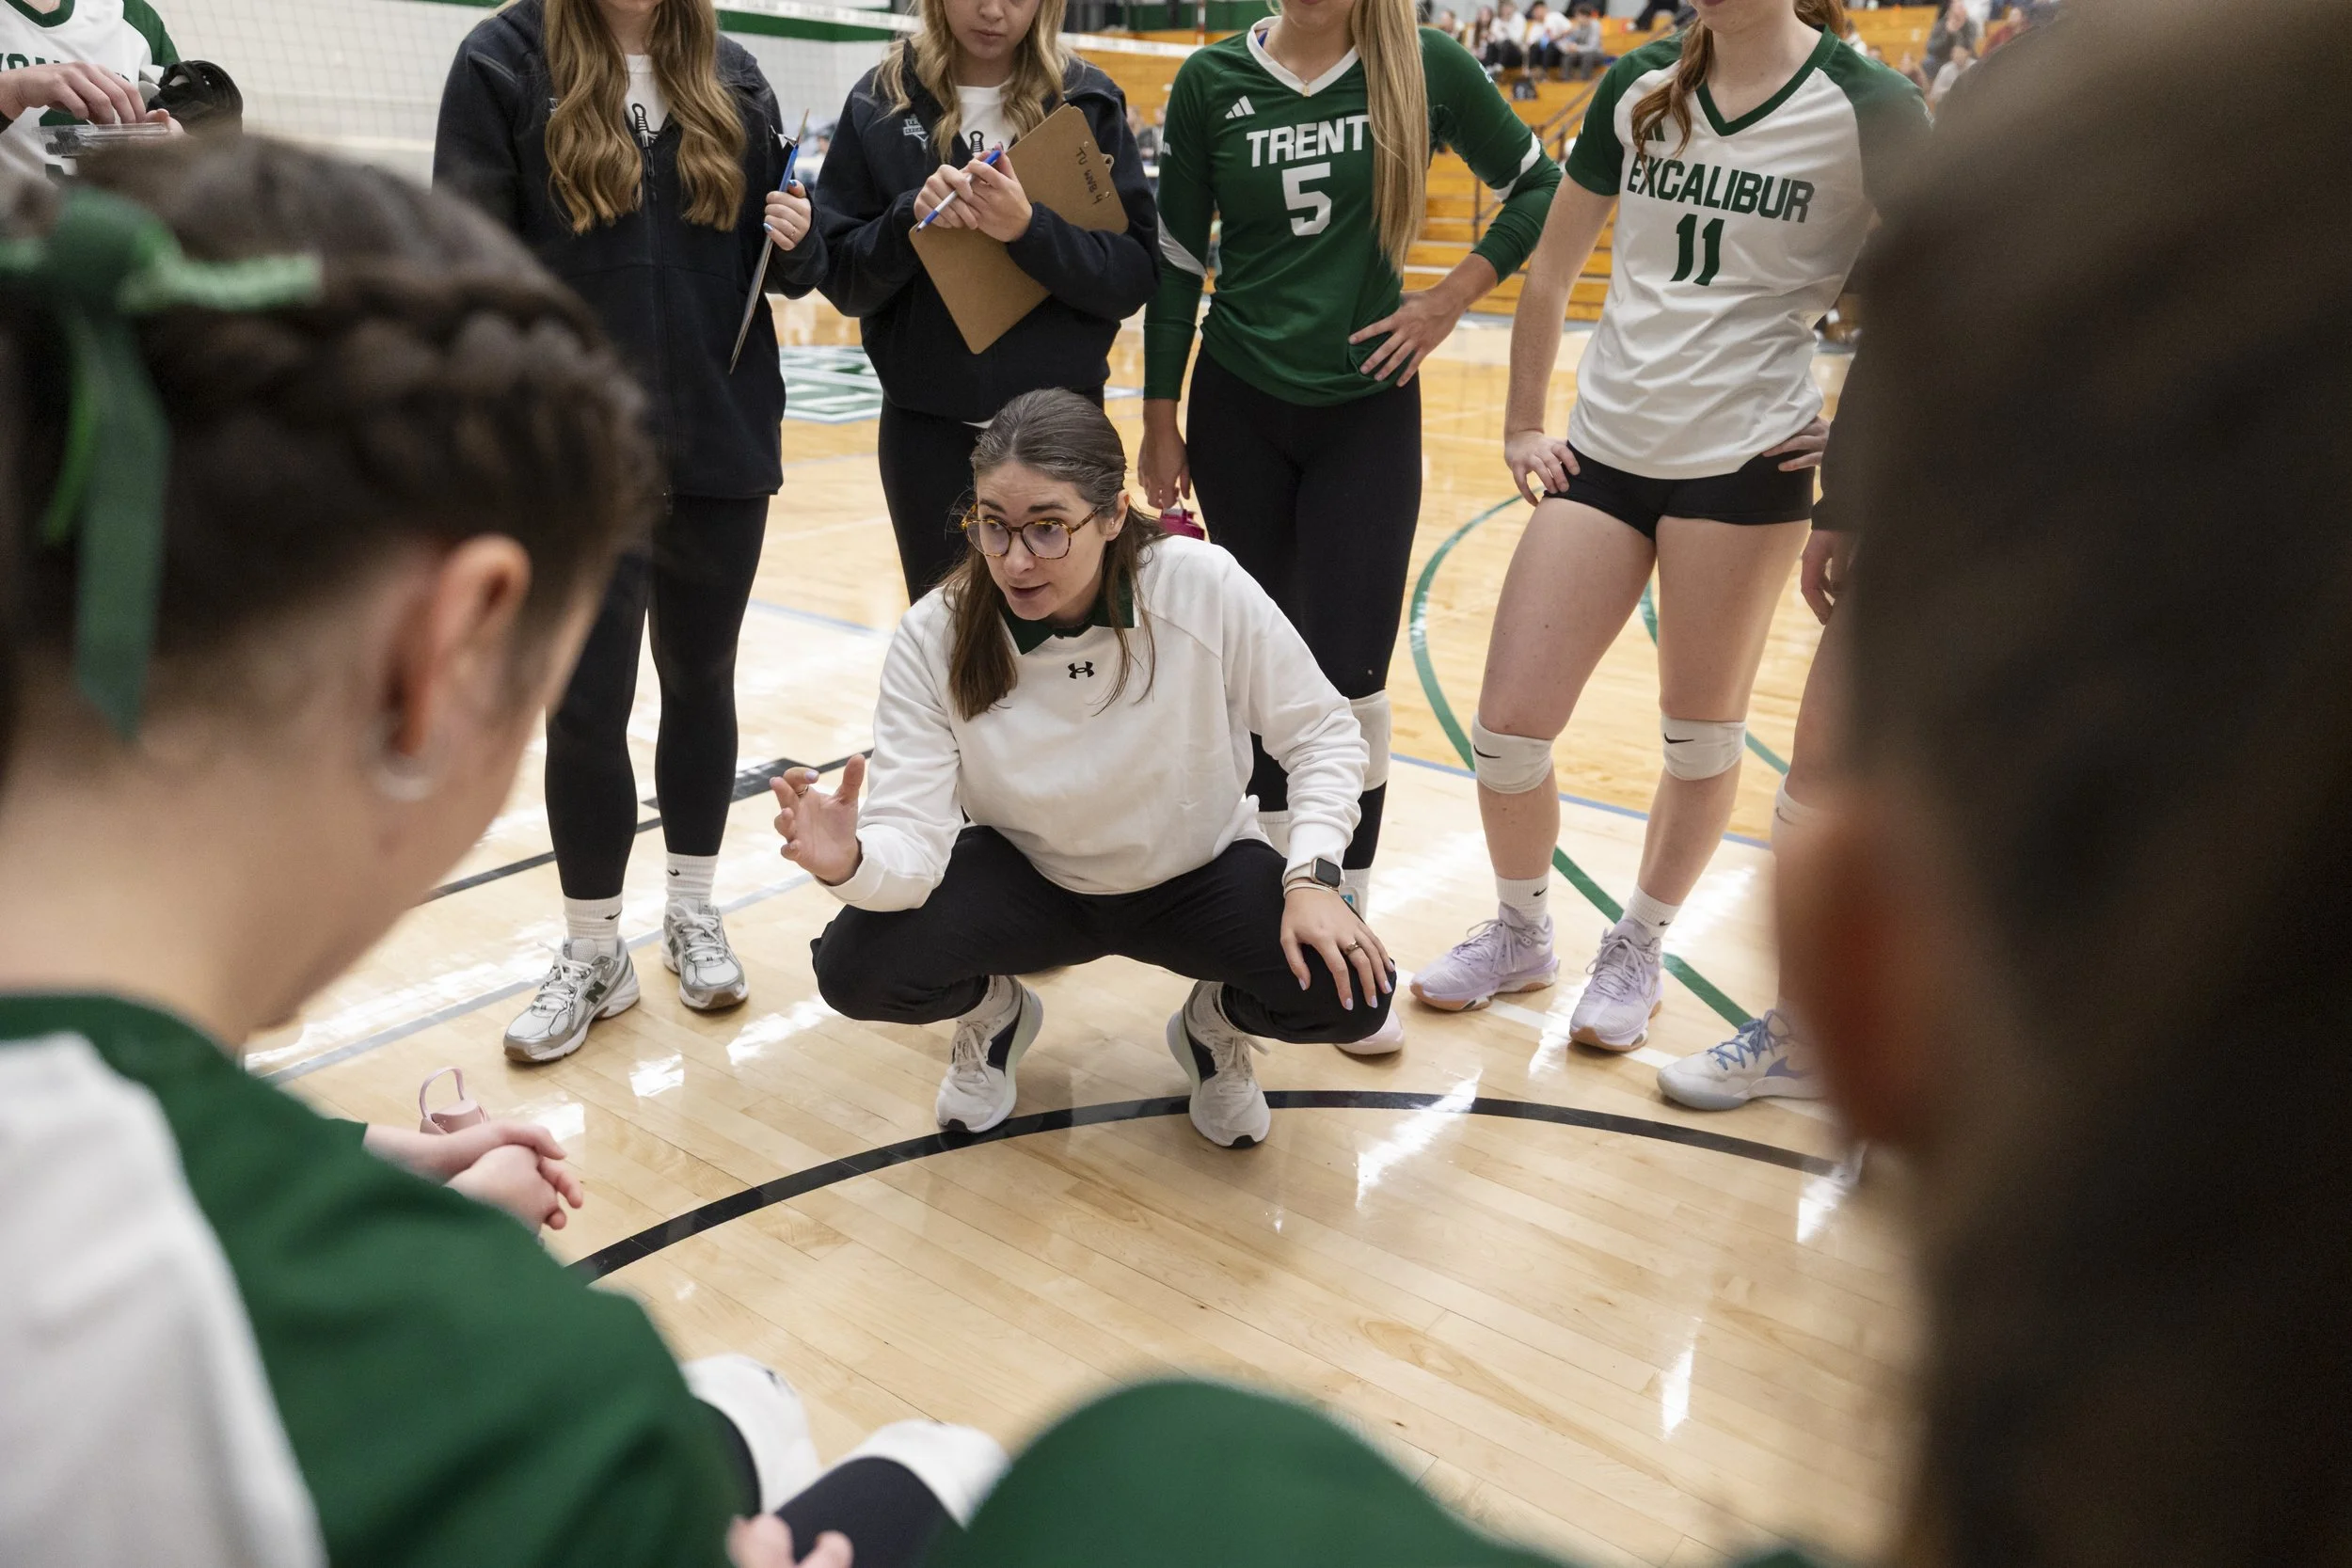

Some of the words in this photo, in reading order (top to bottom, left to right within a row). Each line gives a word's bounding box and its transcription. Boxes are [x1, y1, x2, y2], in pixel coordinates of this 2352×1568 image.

[1075, 147, 1089, 166] TU
[1246, 114, 1371, 167] TRENT
[1281, 162, 1332, 237] 5
[1627, 151, 1816, 224] EXCALIBUR
[1669, 213, 1725, 287] 11
